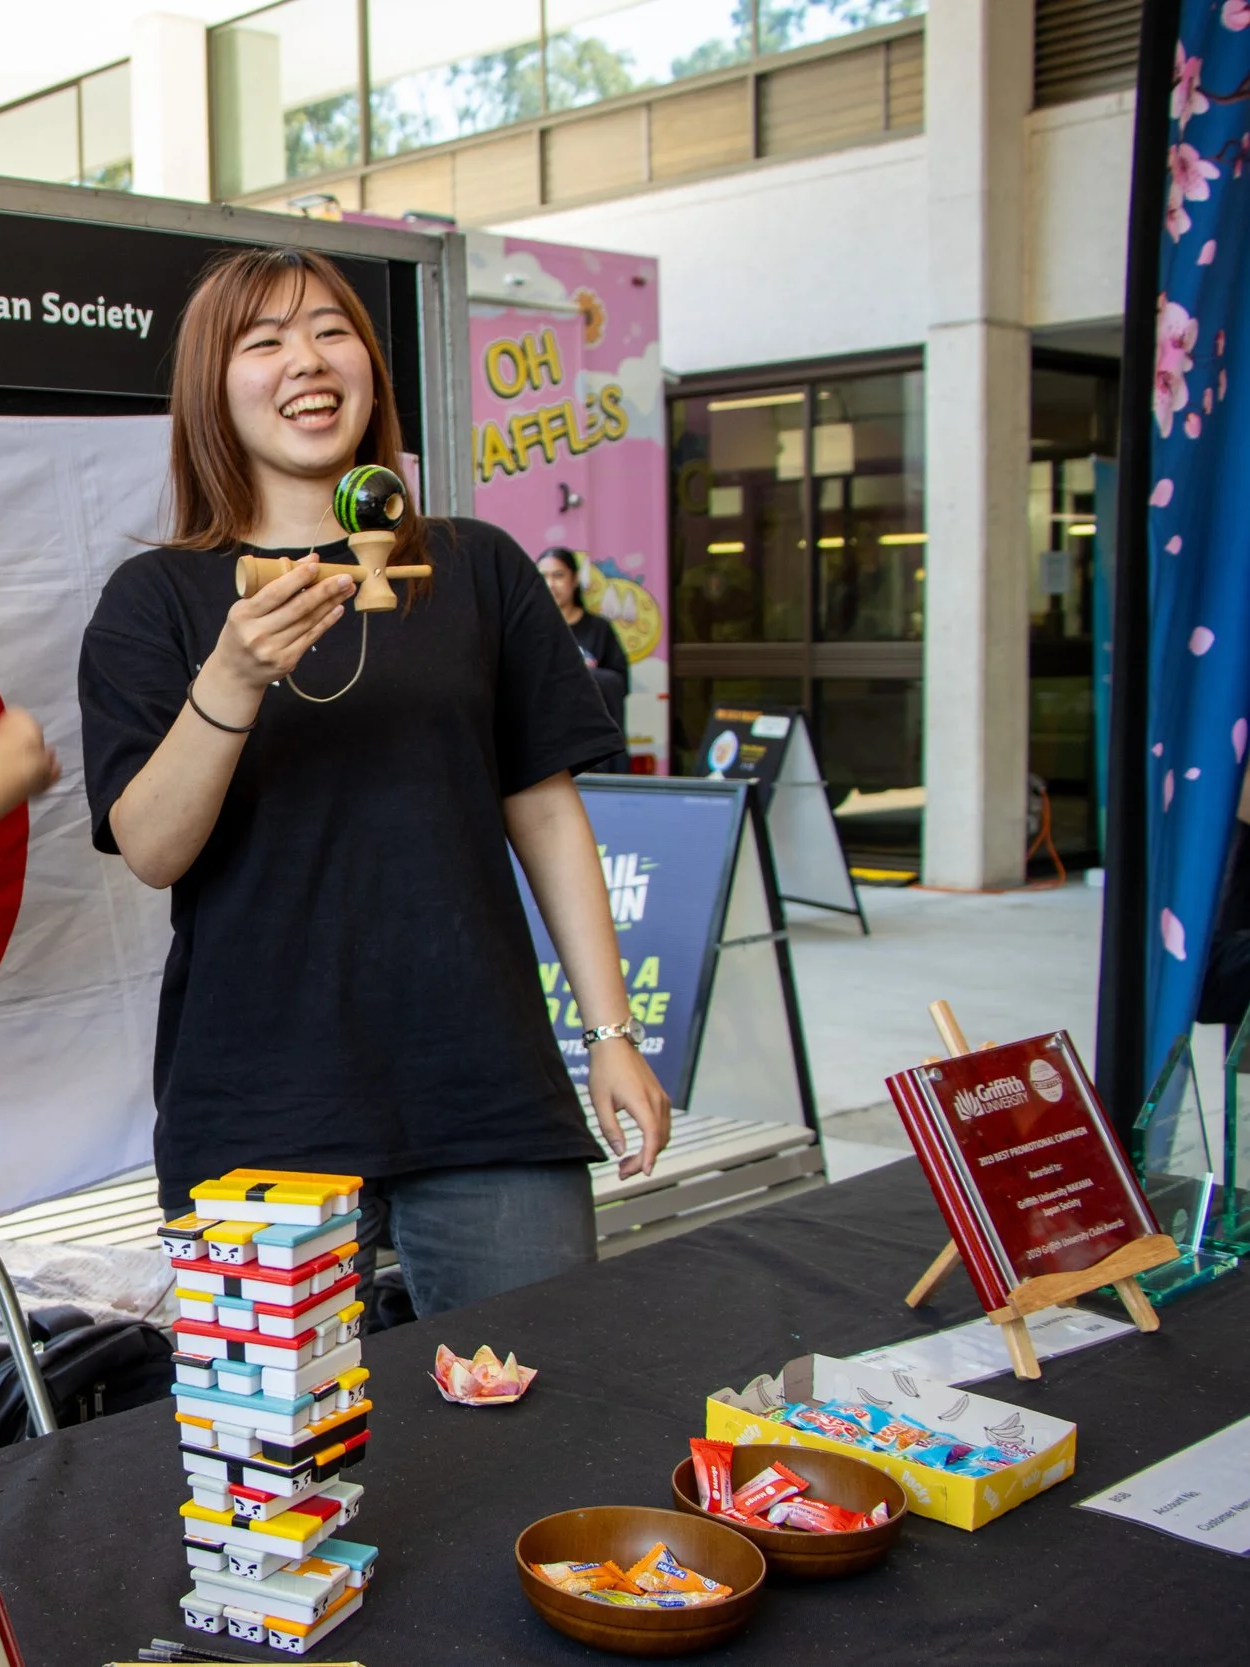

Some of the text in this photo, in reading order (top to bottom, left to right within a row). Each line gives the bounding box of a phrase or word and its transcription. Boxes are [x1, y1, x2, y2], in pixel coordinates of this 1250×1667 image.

[42, 291, 154, 339] Society
[485, 328, 562, 399] OH
[471, 385, 629, 483] AFFLES
[976, 1076, 1026, 1102] Griffith
[982, 1092, 1029, 1114] UNIVERSITY
[978, 1126, 1088, 1167] 2019 BEST PROMOTIONAL CAMPAIGN
[1065, 1178, 1094, 1193] NAKAMA
[1026, 1246, 1042, 1260] 2019
[711, 1465, 719, 1489] Mango
[745, 1491, 767, 1506] Mango
[803, 1499, 830, 1510] Mango
[1152, 1495, 1186, 1515] Account
[1196, 1498, 1250, 1531] Customer Nam
